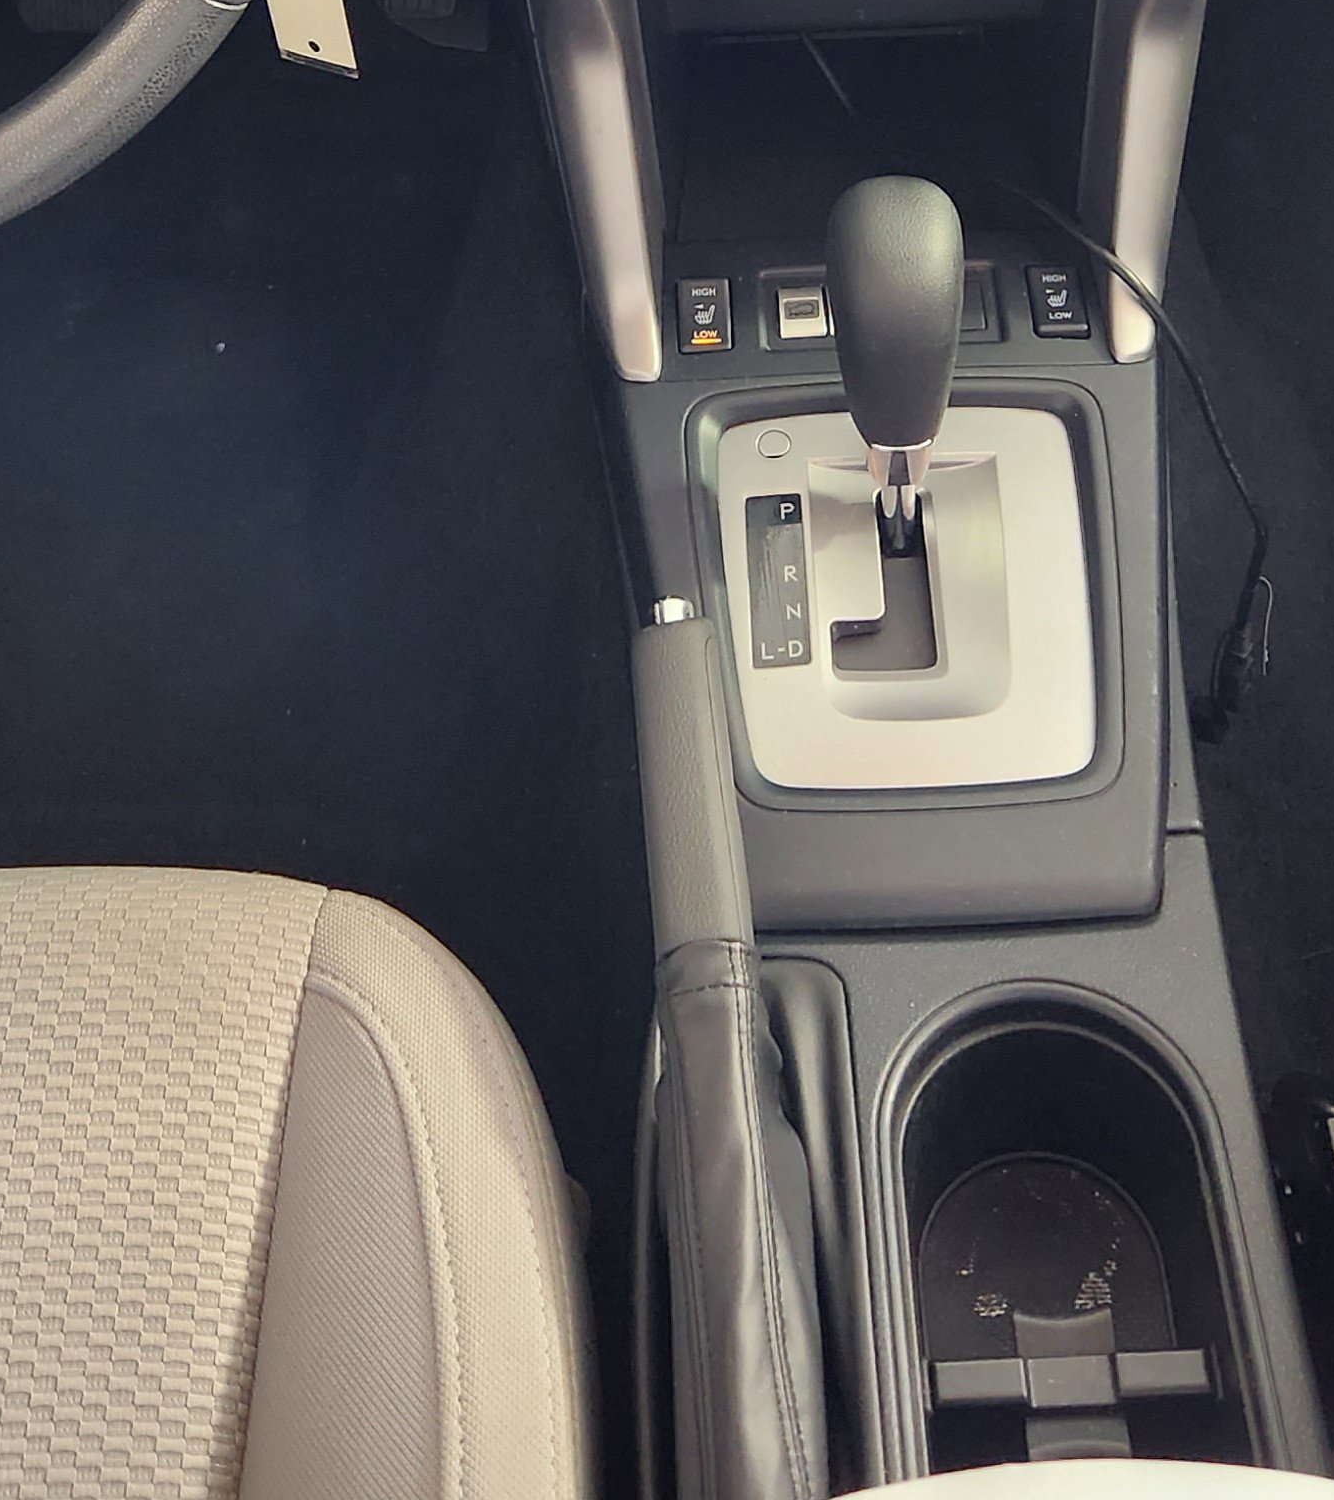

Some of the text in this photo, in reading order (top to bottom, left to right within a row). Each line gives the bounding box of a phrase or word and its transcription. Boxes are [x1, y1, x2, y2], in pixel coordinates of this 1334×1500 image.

[1041, 272, 1067, 285] HIGH
[691, 285, 717, 298] HIGH
[1047, 309, 1073, 321] LOW
[692, 328, 719, 341] LOW
[779, 502, 795, 521] P
[783, 565, 799, 583] R
[786, 603, 803, 621] N
